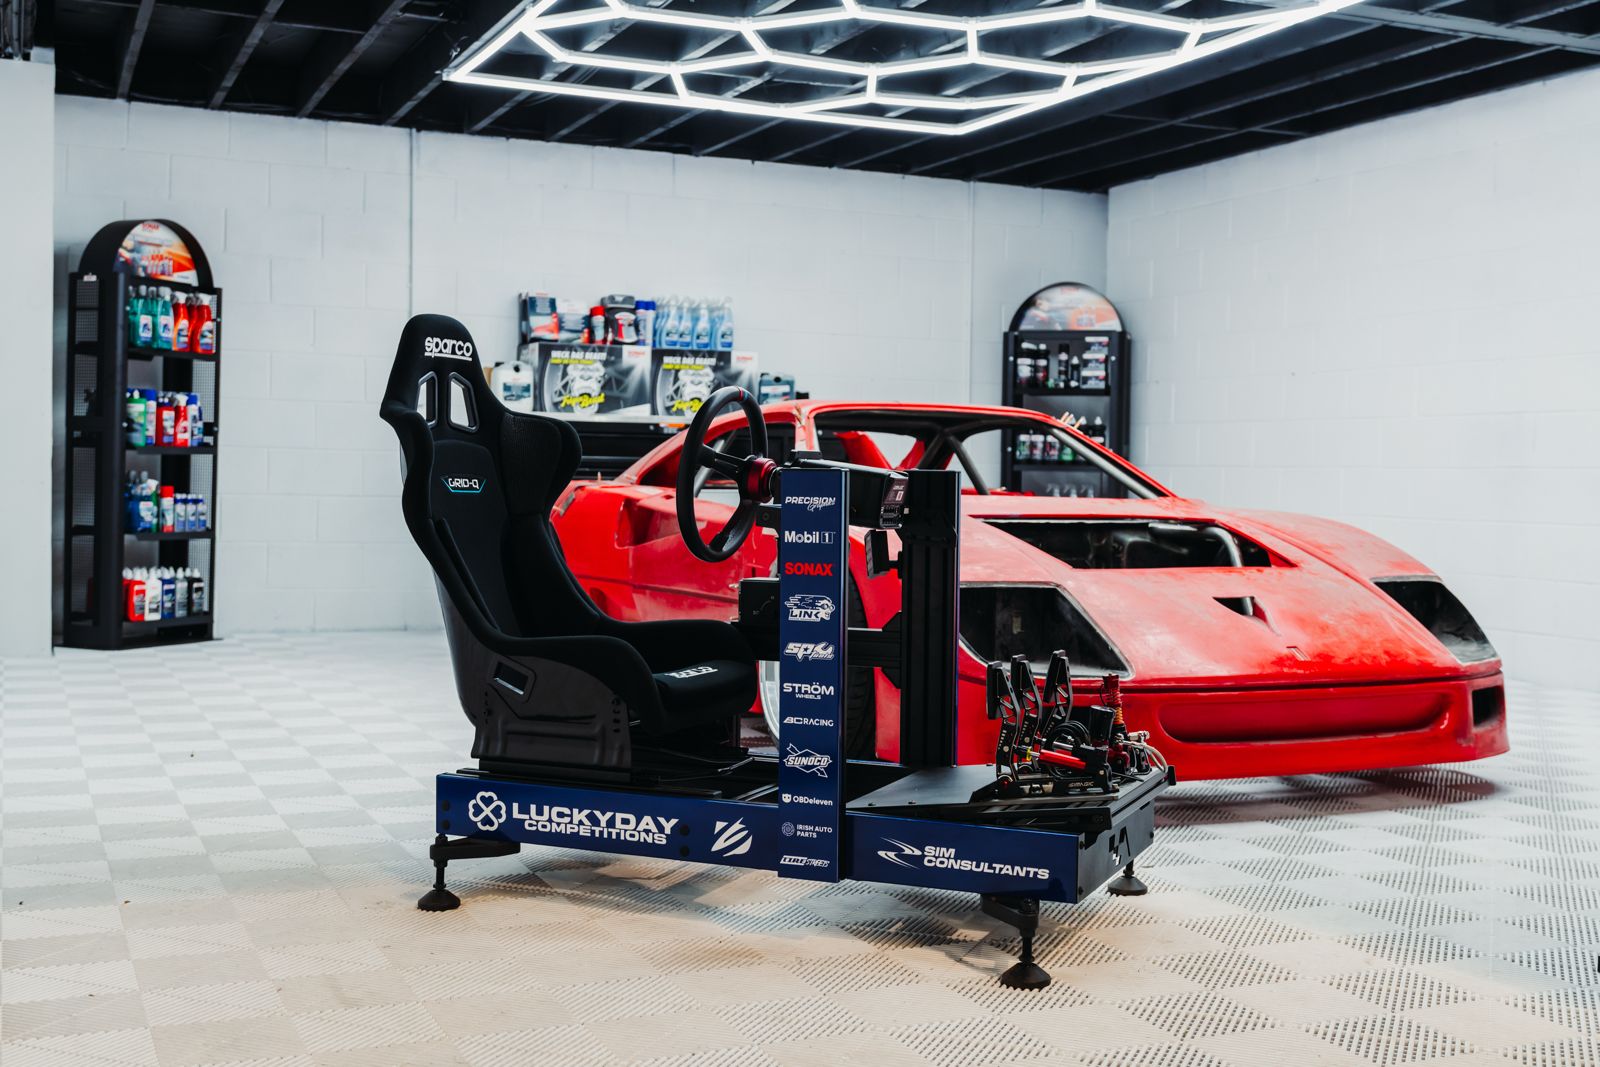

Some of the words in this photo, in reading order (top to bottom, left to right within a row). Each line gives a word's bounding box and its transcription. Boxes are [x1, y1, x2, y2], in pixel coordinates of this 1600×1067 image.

[425, 336, 473, 358] sparco
[448, 478, 479, 489] GRID-Q
[785, 496, 836, 505] PRECISION
[784, 531, 820, 543] Mobil
[785, 561, 833, 576] SONAX
[790, 610, 820, 618] LINK
[783, 682, 835, 695] STRÖM
[803, 718, 834, 727] RACING
[787, 756, 828, 766] SUNOCO
[793, 796, 833, 806] OBDeleven
[512, 802, 680, 835] LUCKYDAY
[524, 819, 667, 845] COMPETITIONS
[923, 845, 956, 859] SIM
[923, 856, 1050, 880] CONSULTANTS
